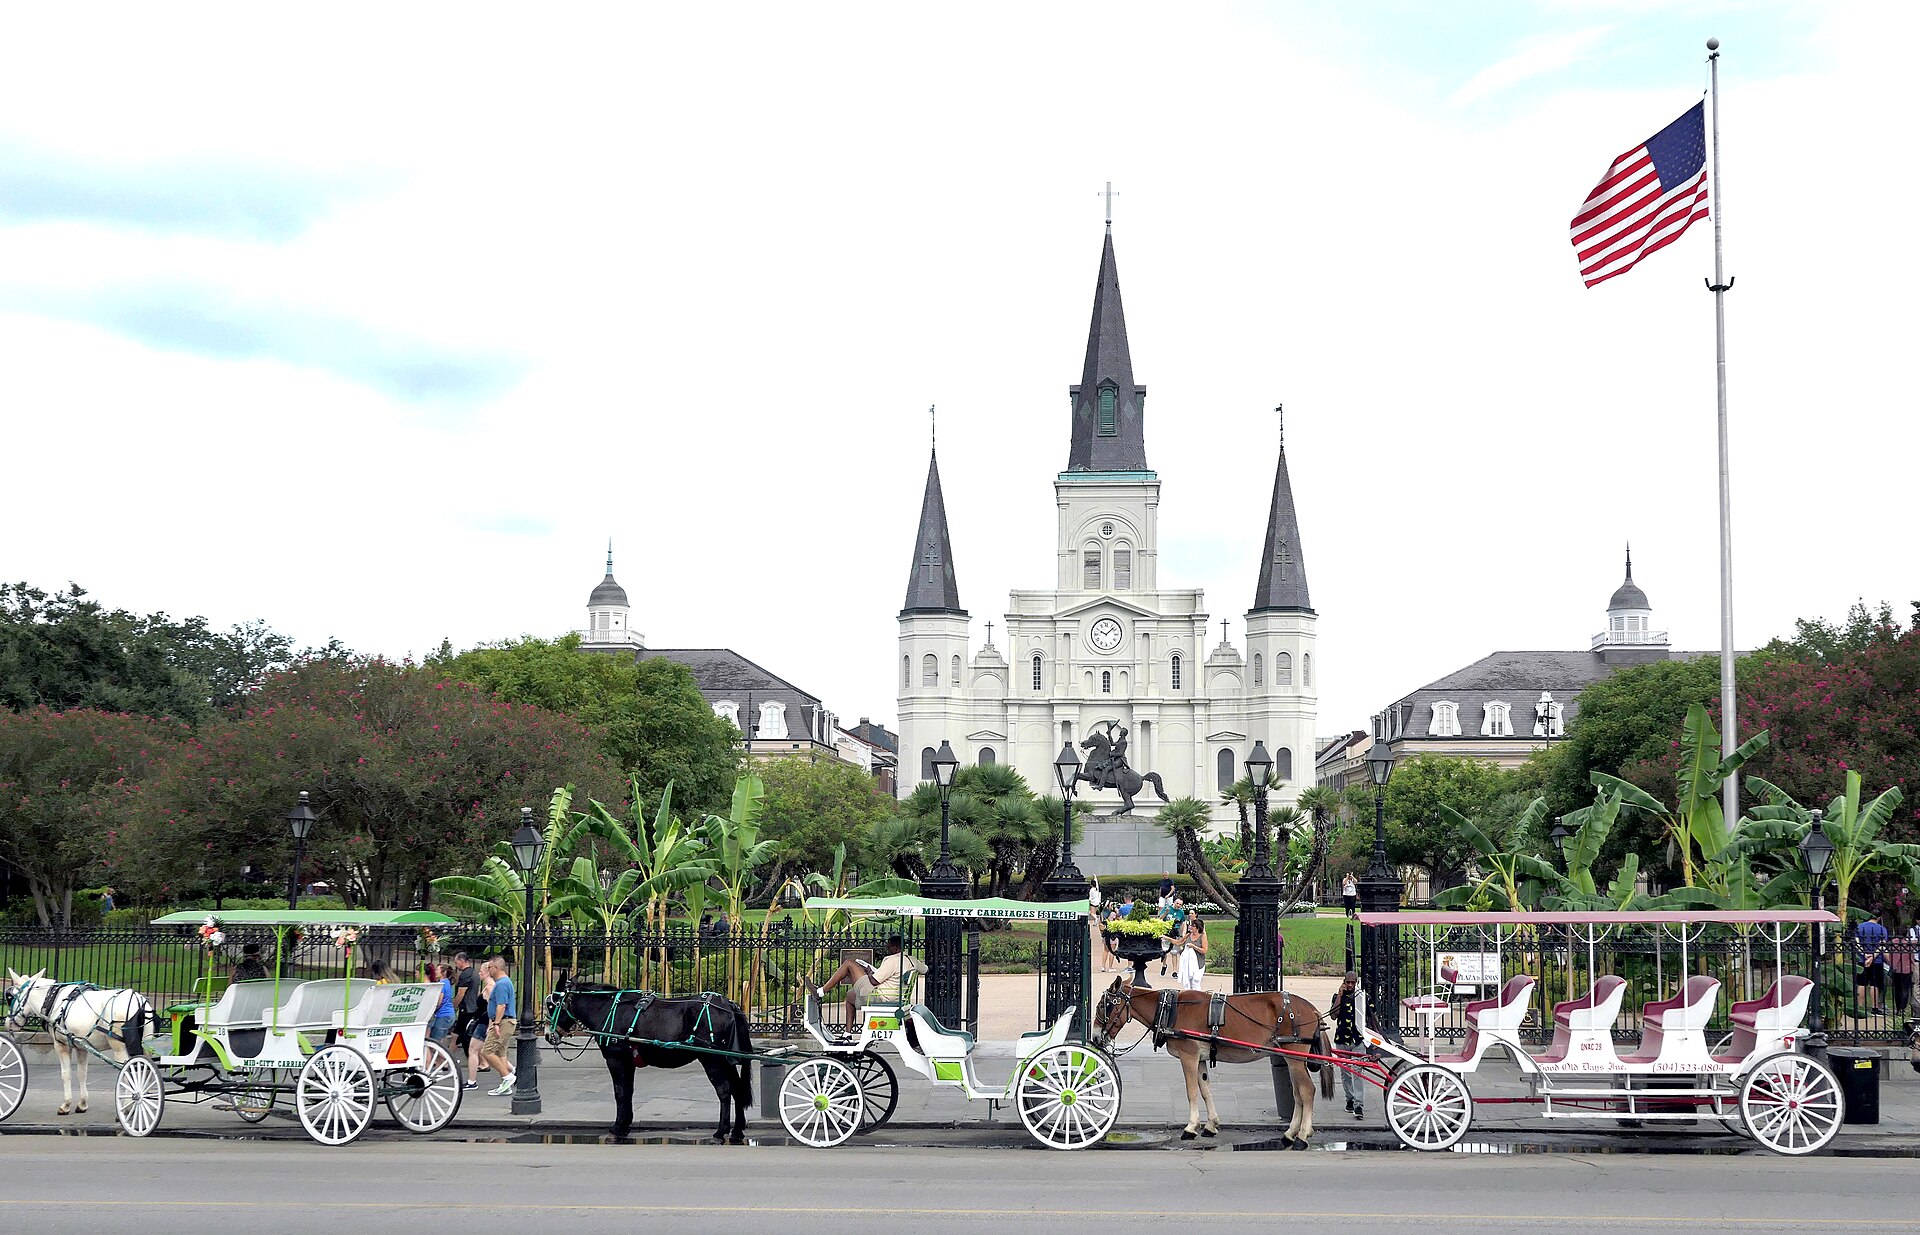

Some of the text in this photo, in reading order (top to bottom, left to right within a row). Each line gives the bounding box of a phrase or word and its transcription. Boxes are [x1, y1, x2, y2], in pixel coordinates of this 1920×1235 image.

[922, 907, 973, 916] MID-CITY
[977, 909, 1035, 918] CARRIAGES
[391, 986, 426, 998] MID-CITY
[243, 1059, 275, 1067] MID-CITY
[1561, 1062, 1578, 1071] Old
[1582, 1062, 1604, 1073] Days
